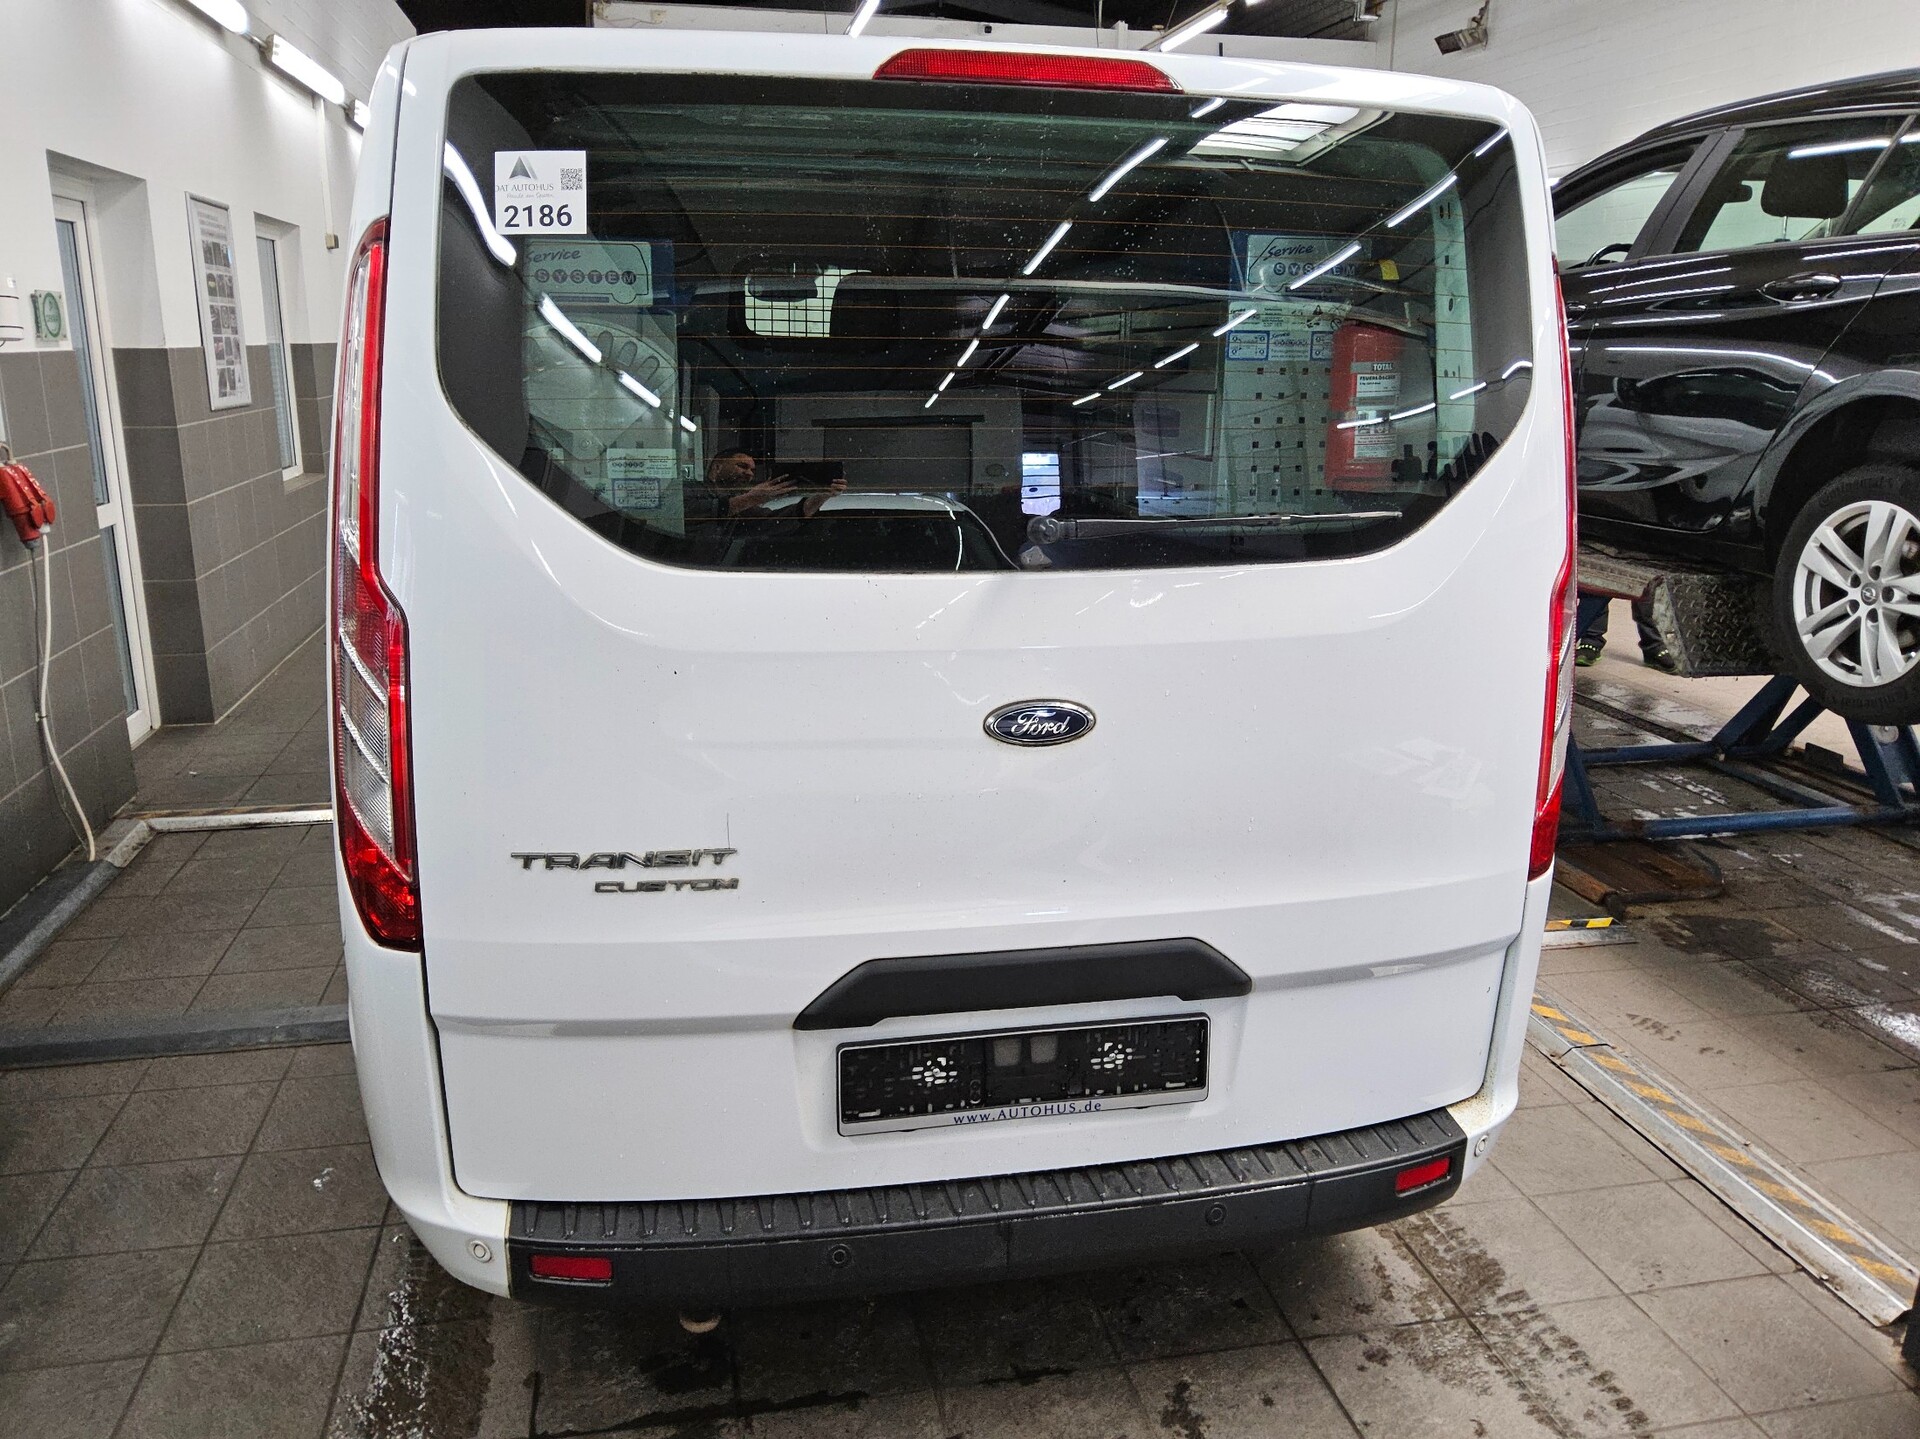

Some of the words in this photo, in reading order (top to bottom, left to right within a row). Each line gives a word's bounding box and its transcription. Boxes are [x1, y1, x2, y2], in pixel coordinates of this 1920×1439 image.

[511, 183, 554, 192] AUTOHUS
[504, 204, 572, 227] 2186
[1263, 244, 1314, 261] Service
[535, 268, 636, 285] SYSTEM
[1274, 262, 1356, 276] SYSEM
[1373, 363, 1393, 371] TOTAL
[1010, 709, 1071, 737] Ford
[510, 848, 738, 871] TRANSIT
[594, 877, 740, 893] CUSTOM
[953, 1100, 1102, 1124] www.AUTOHUS.de
